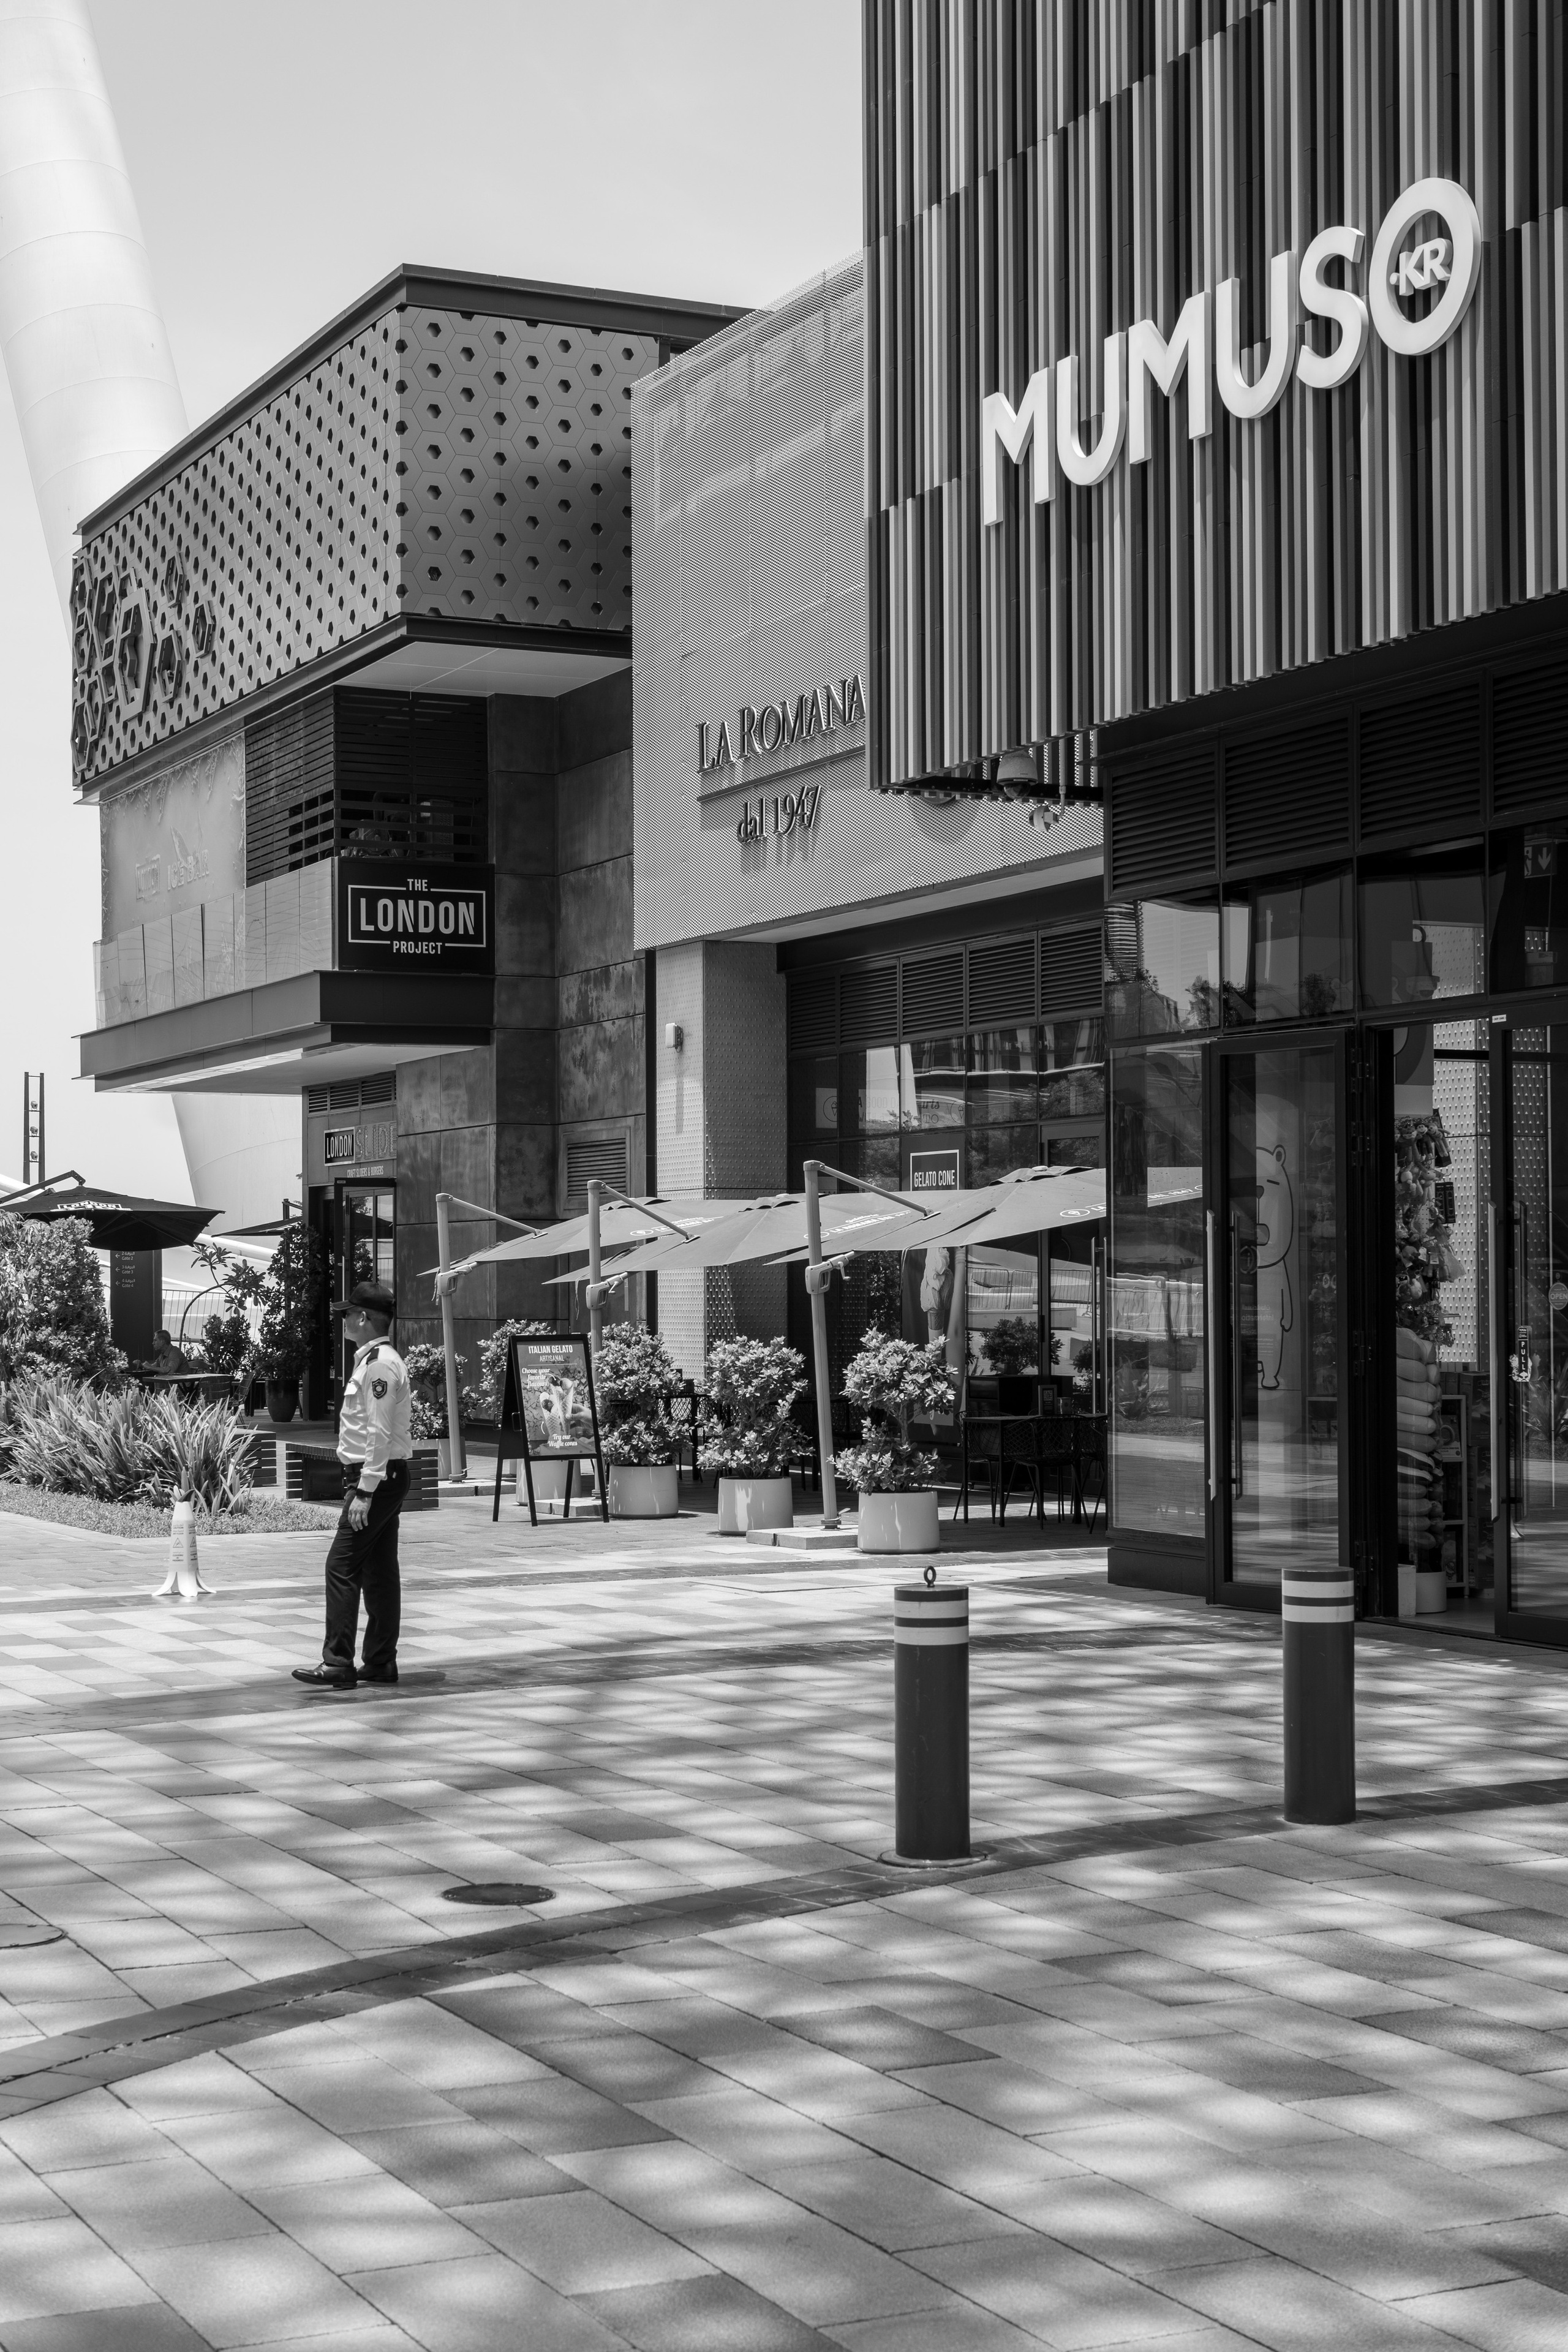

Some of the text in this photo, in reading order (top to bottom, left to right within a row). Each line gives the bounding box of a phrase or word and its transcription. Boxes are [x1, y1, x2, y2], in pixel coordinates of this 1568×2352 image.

[982, 177, 1482, 526] MUMUSO
[697, 674, 865, 774] LA ROMANA
[737, 786, 821, 843] dal 1947
[407, 878, 428, 892] THE
[360, 897, 475, 935] LONDON
[393, 941, 442, 954] PROJECT
[326, 1134, 353, 1158] LONDON
[347, 1166, 383, 1178] CRAFT SLIDERS & BURGERS
[914, 1169, 955, 1188] GELATO CONE
[551, 1344, 573, 1353] GELATO
[547, 1440, 564, 1449] Waffle
